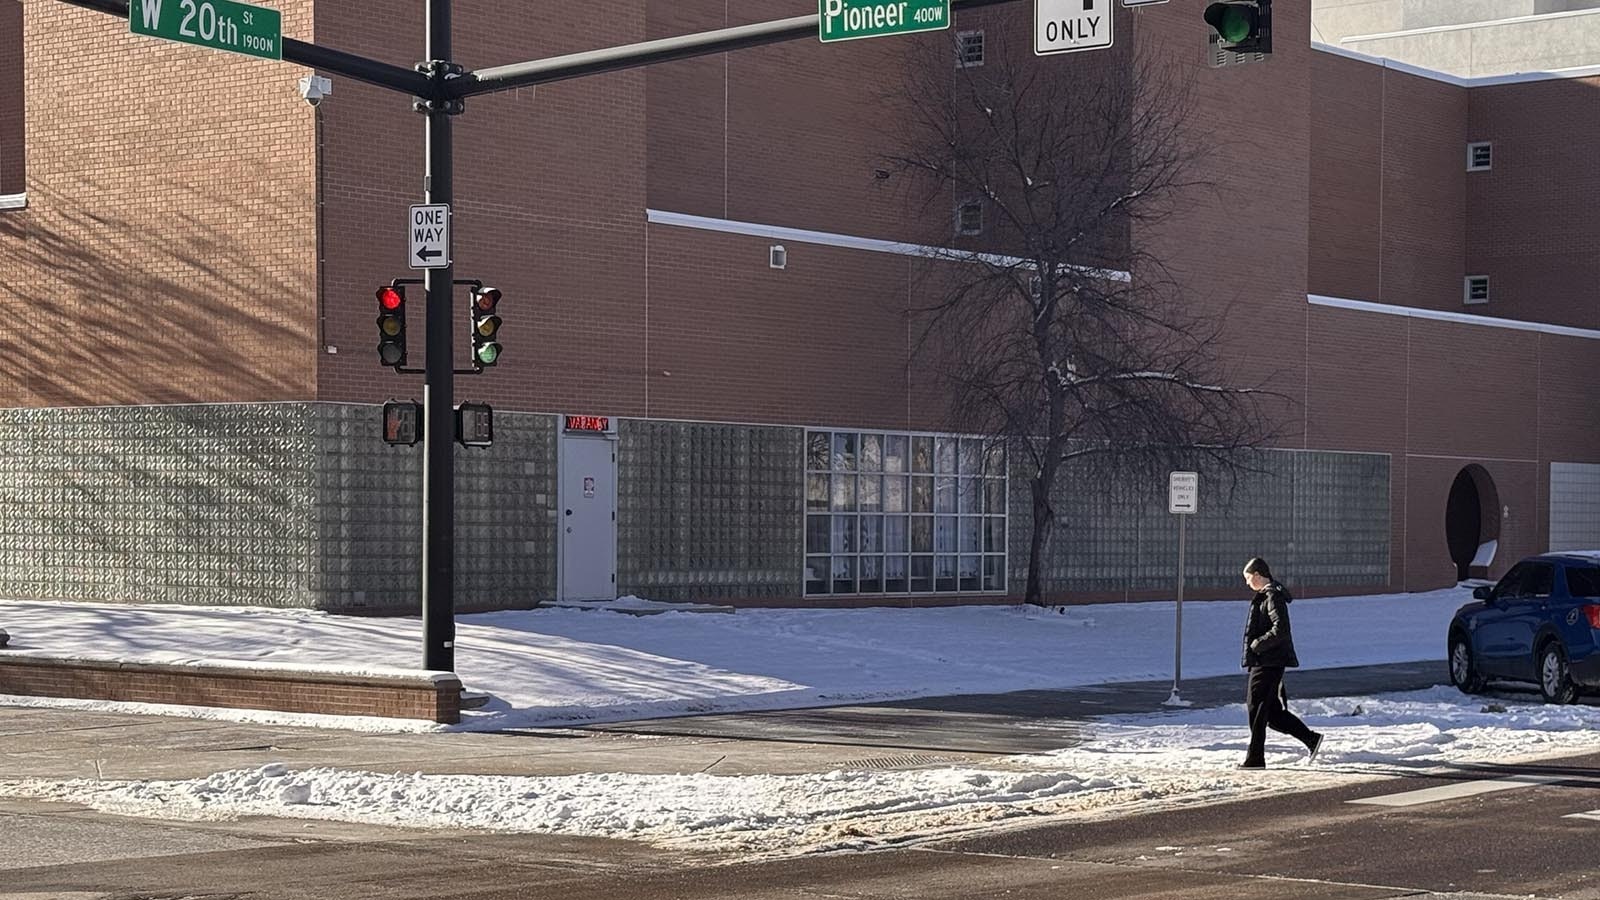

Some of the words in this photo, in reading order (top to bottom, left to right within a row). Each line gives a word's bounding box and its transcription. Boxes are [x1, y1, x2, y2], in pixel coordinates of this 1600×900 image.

[141, 0, 162, 30] W
[179, 0, 238, 46] 20th
[243, 11, 254, 26] St
[825, 0, 908, 34] Pioneer
[914, 6, 943, 23] 400W
[1046, 16, 1101, 42] ONLY
[243, 34, 273, 52] 1900N
[415, 210, 443, 226] ONE
[414, 227, 444, 243] WAY
